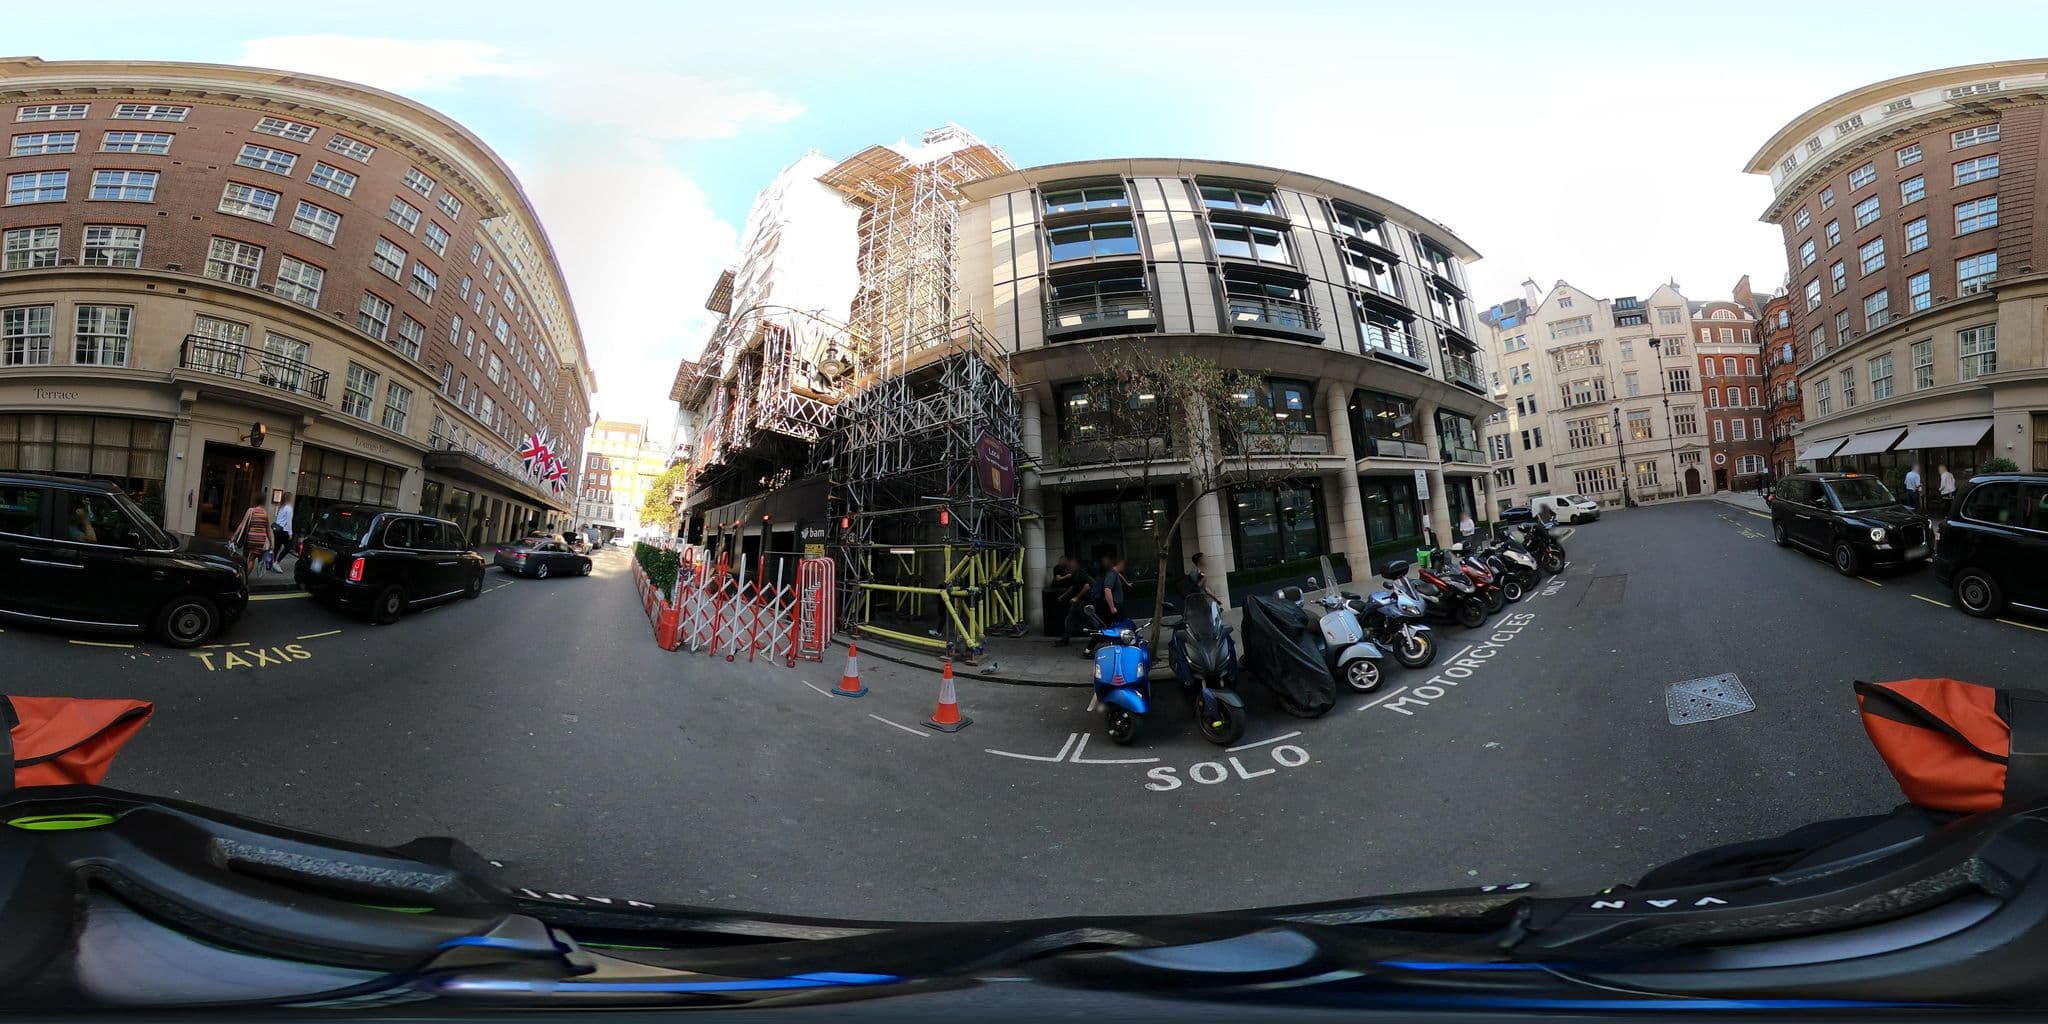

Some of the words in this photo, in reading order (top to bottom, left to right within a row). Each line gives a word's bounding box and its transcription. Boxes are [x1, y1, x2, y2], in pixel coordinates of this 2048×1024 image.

[33, 387, 79, 399] Terrace
[810, 528, 824, 537] bam
[1542, 580, 1567, 595] ONLY
[189, 645, 311, 671] TAXIS
[1383, 613, 1535, 716] MOTORCYCLES
[1145, 745, 1310, 791] SOLO
